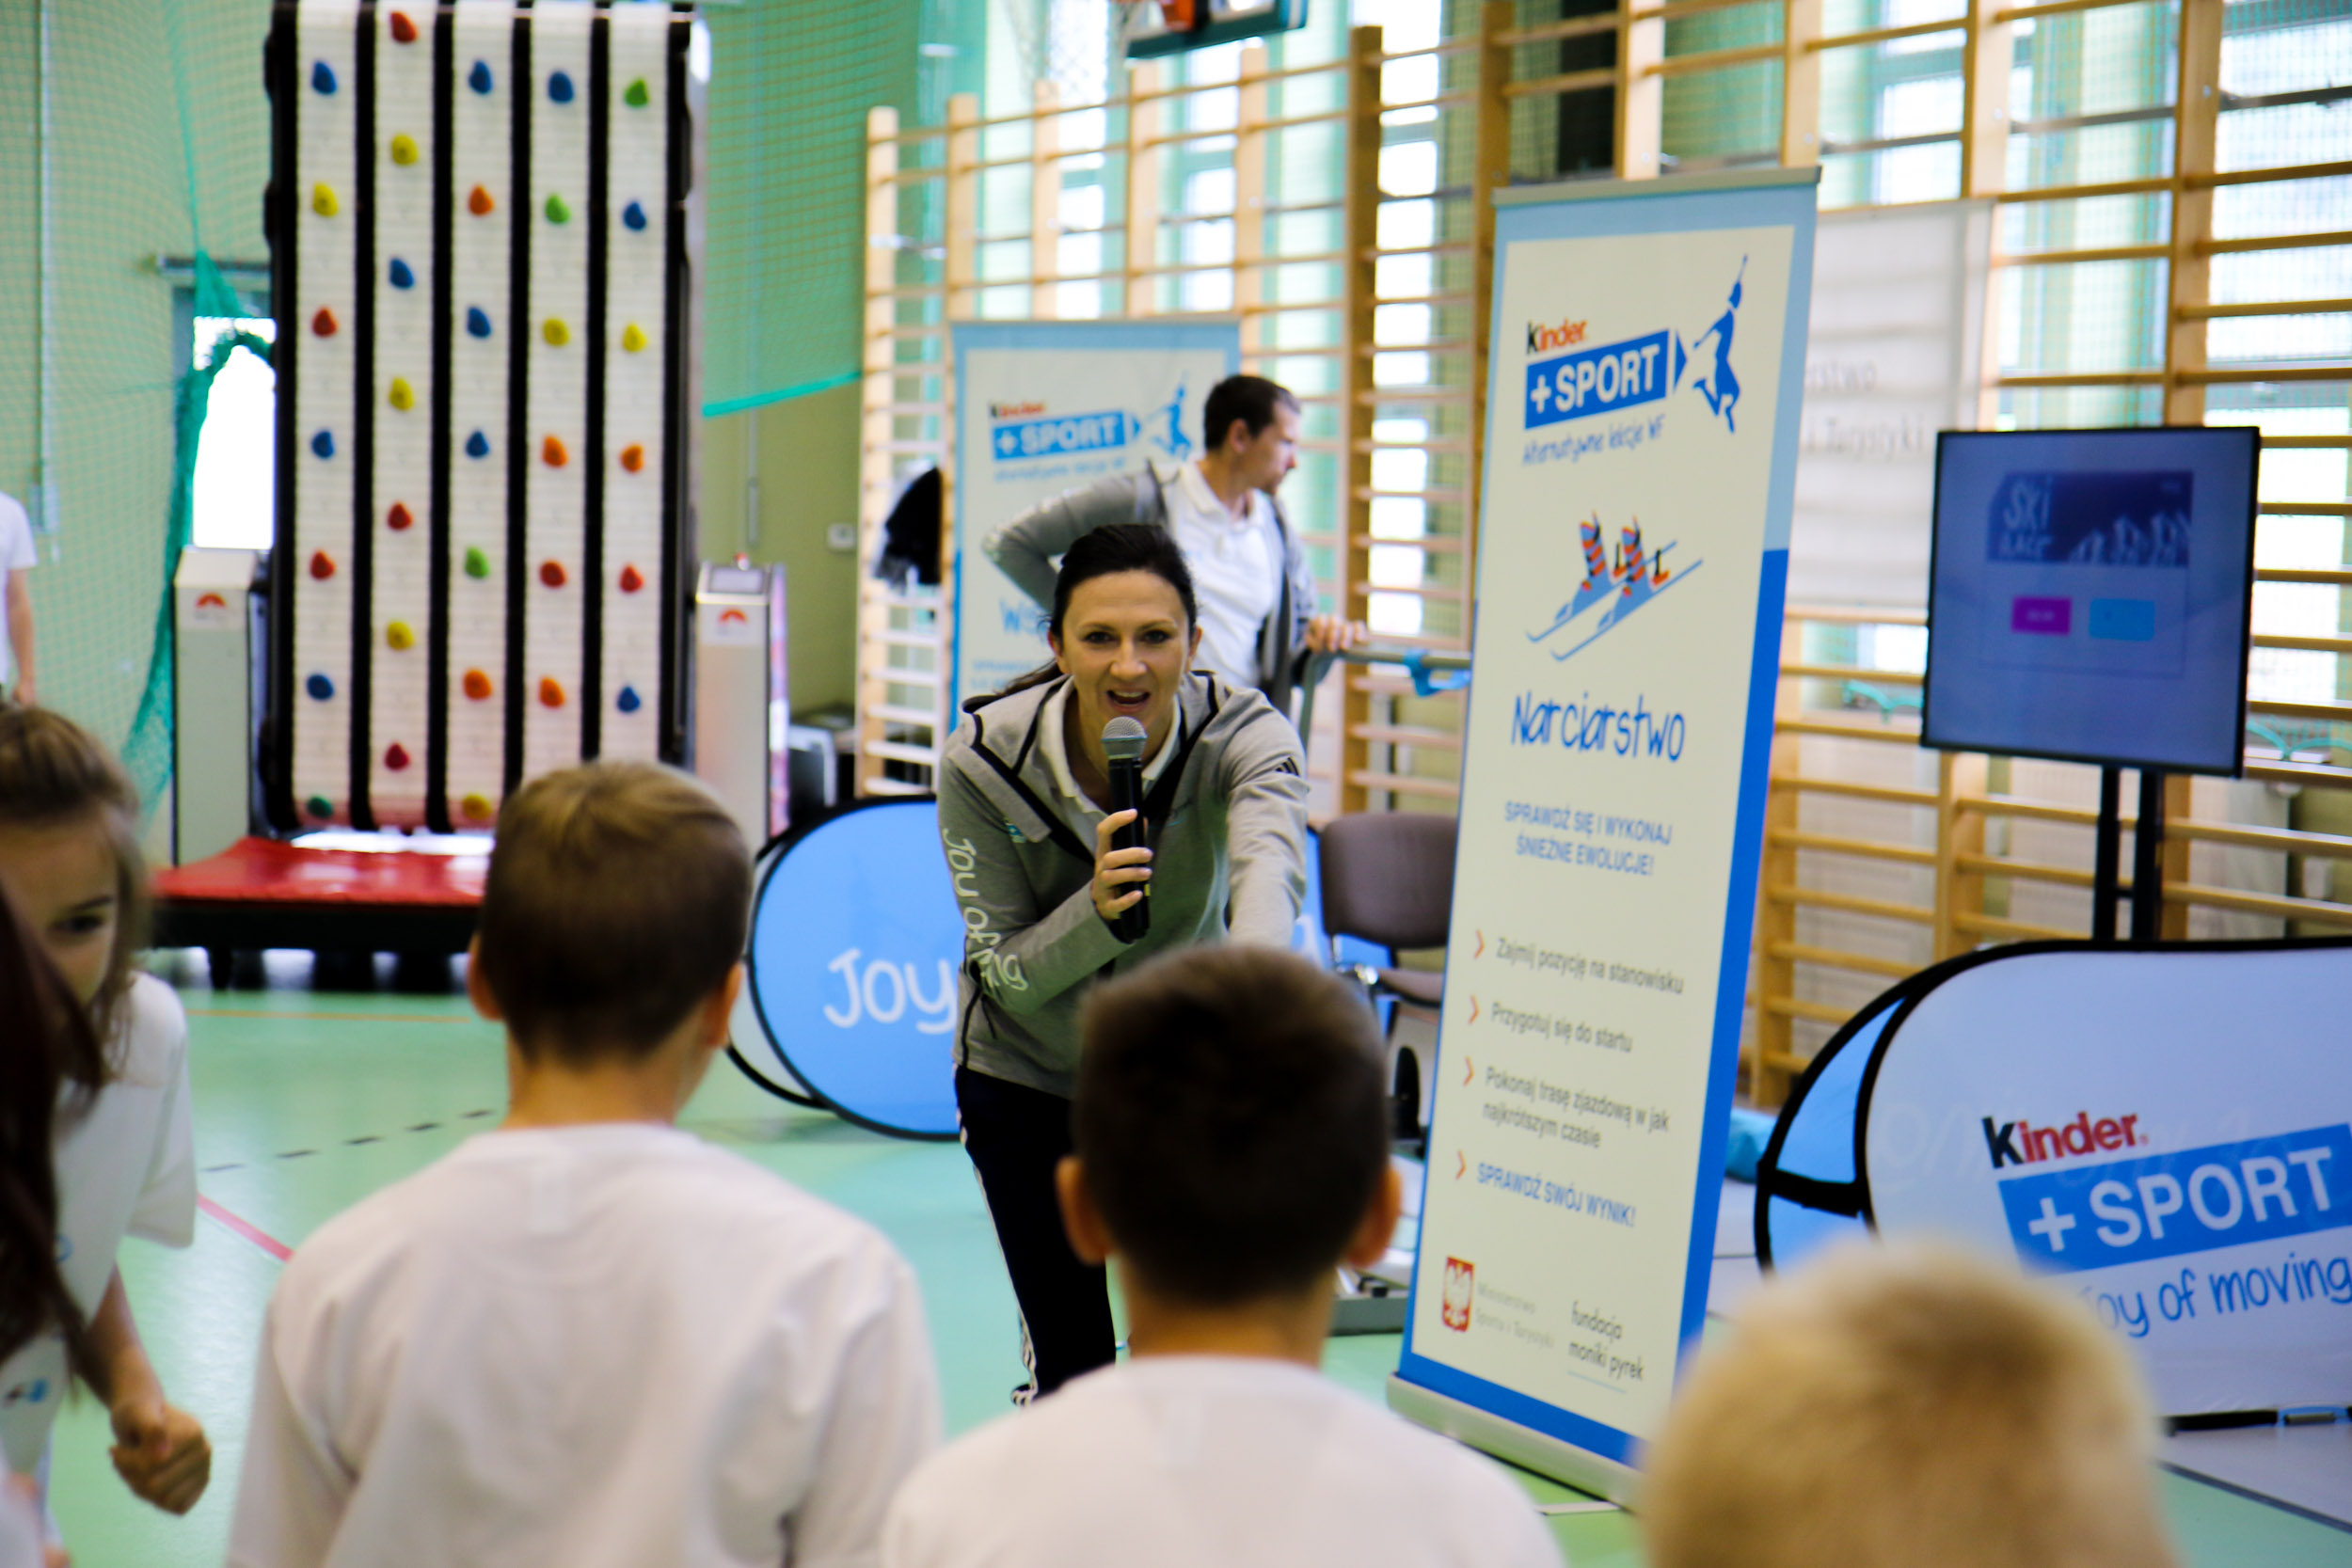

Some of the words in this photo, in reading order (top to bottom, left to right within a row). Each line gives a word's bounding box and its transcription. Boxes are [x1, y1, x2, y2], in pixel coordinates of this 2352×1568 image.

[1510, 689, 1686, 763] Narciarstwo
[1605, 815, 1673, 847] WYKONAJ
[822, 947, 959, 1035] Joy
[1589, 959, 1606, 980] na
[1608, 963, 1685, 995] stanowisku
[1575, 1020, 1593, 1044] do
[1595, 1027, 1633, 1053] startu
[1486, 1065, 1537, 1102] Pokonaj
[1635, 1107, 1647, 1127] w
[1648, 1104, 1670, 1134] jak
[1560, 1123, 1602, 1148] czasie
[1476, 1162, 1542, 1201] SPRAWDŹ
[1543, 1180, 1584, 1213] SWÓJ
[2157, 1267, 2197, 1323] of
[2209, 1252, 2352, 1315] moving
[1567, 1339, 1608, 1370] moniki
[1608, 1354, 1645, 1383] pyrek
